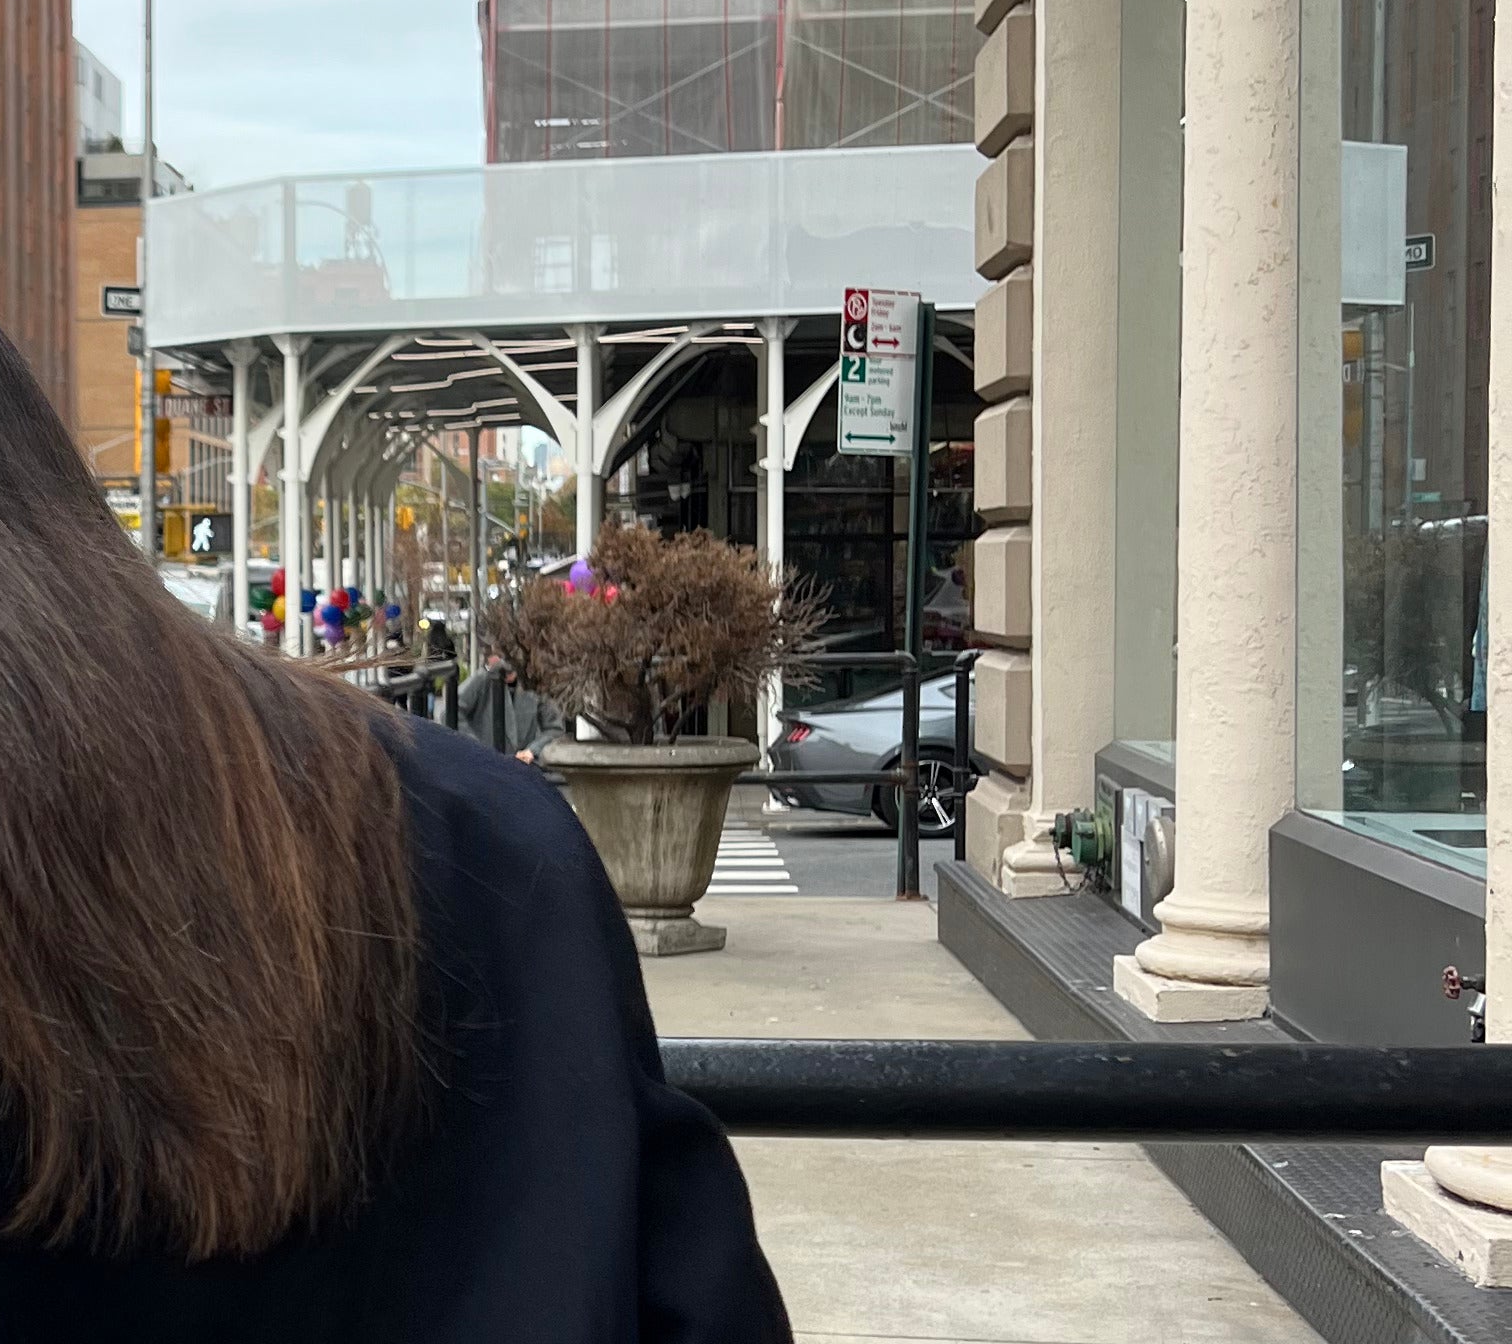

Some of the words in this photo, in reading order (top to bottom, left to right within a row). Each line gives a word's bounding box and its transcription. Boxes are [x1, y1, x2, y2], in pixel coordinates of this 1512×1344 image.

[847, 355, 861, 381] 2
[844, 406, 868, 420] Except
[870, 407, 896, 421] Sunday
